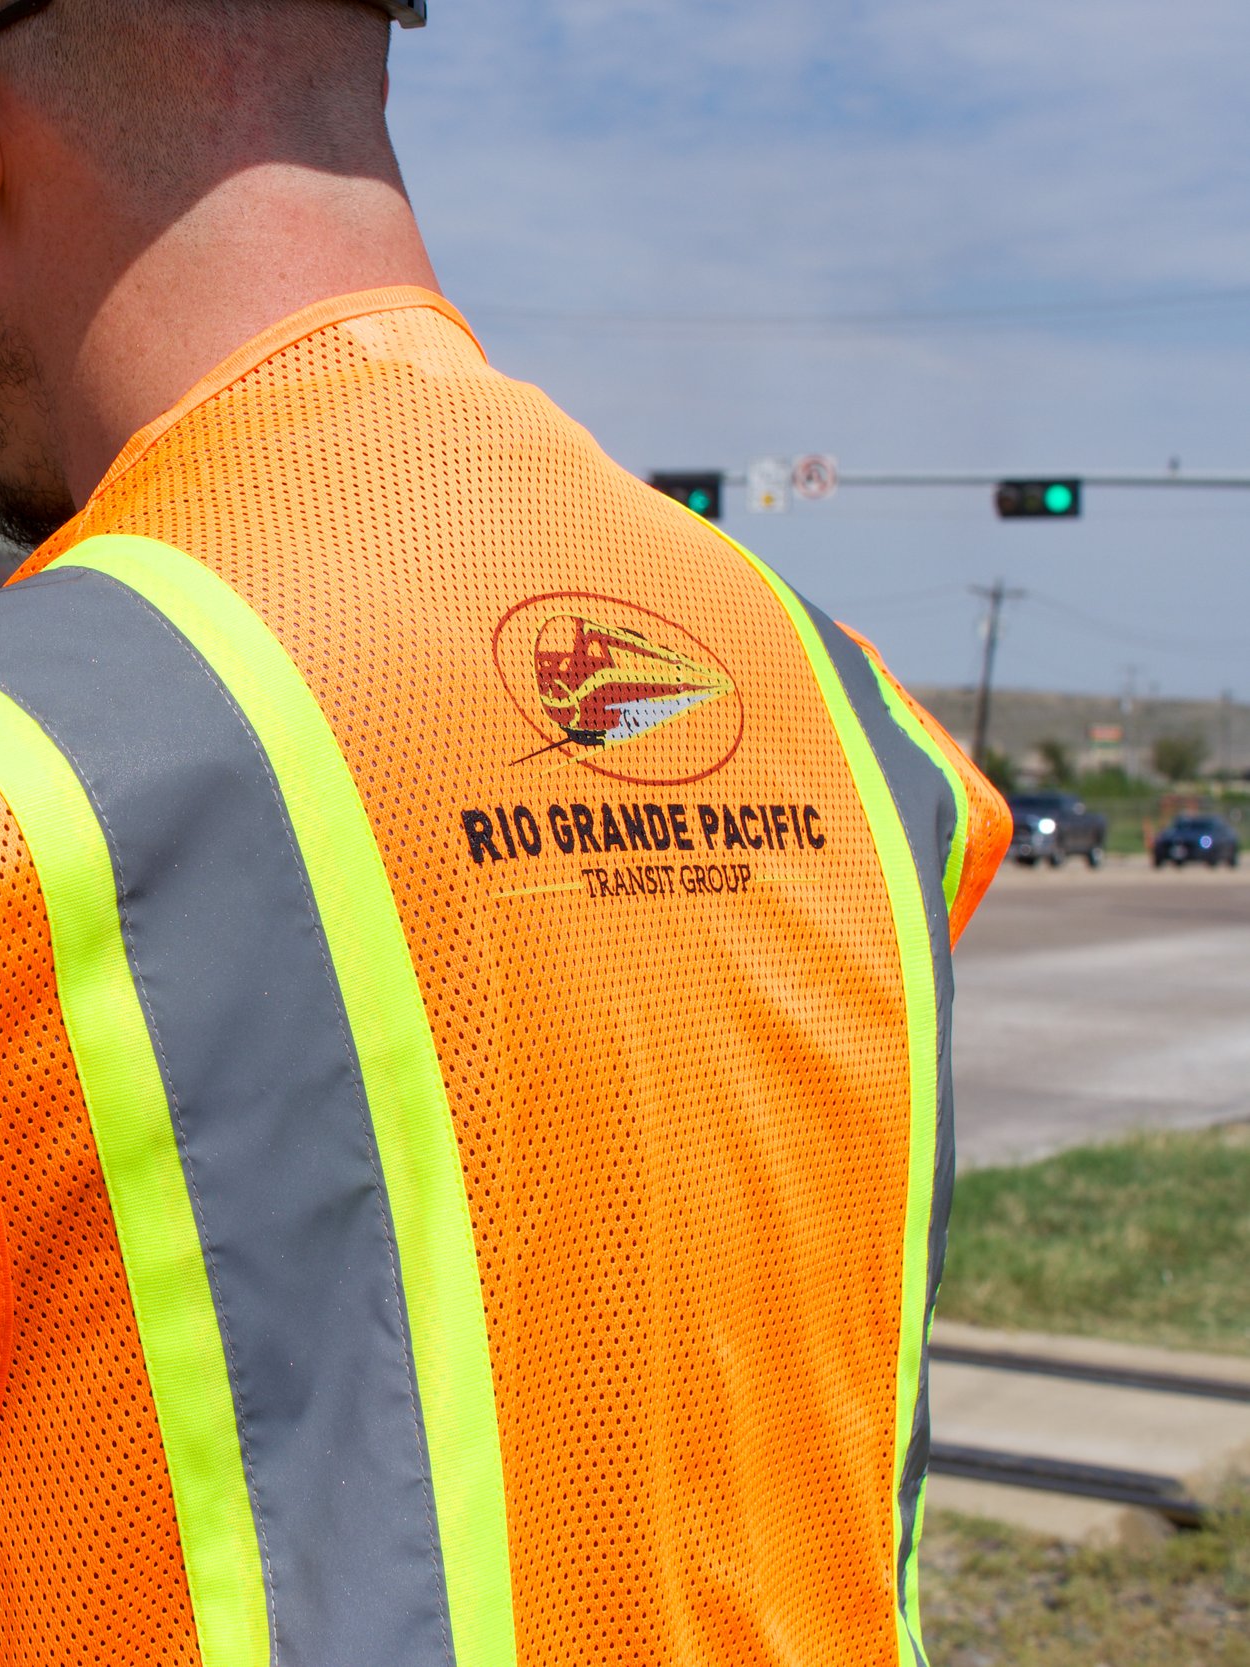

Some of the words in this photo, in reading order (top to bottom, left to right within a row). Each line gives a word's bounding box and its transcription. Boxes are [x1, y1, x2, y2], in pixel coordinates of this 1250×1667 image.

[463, 805, 542, 864] RIO
[547, 802, 695, 854] GRANDE
[698, 804, 825, 851] PACIFIC
[582, 864, 675, 898] TRANSIT
[679, 864, 751, 894] GROUP
